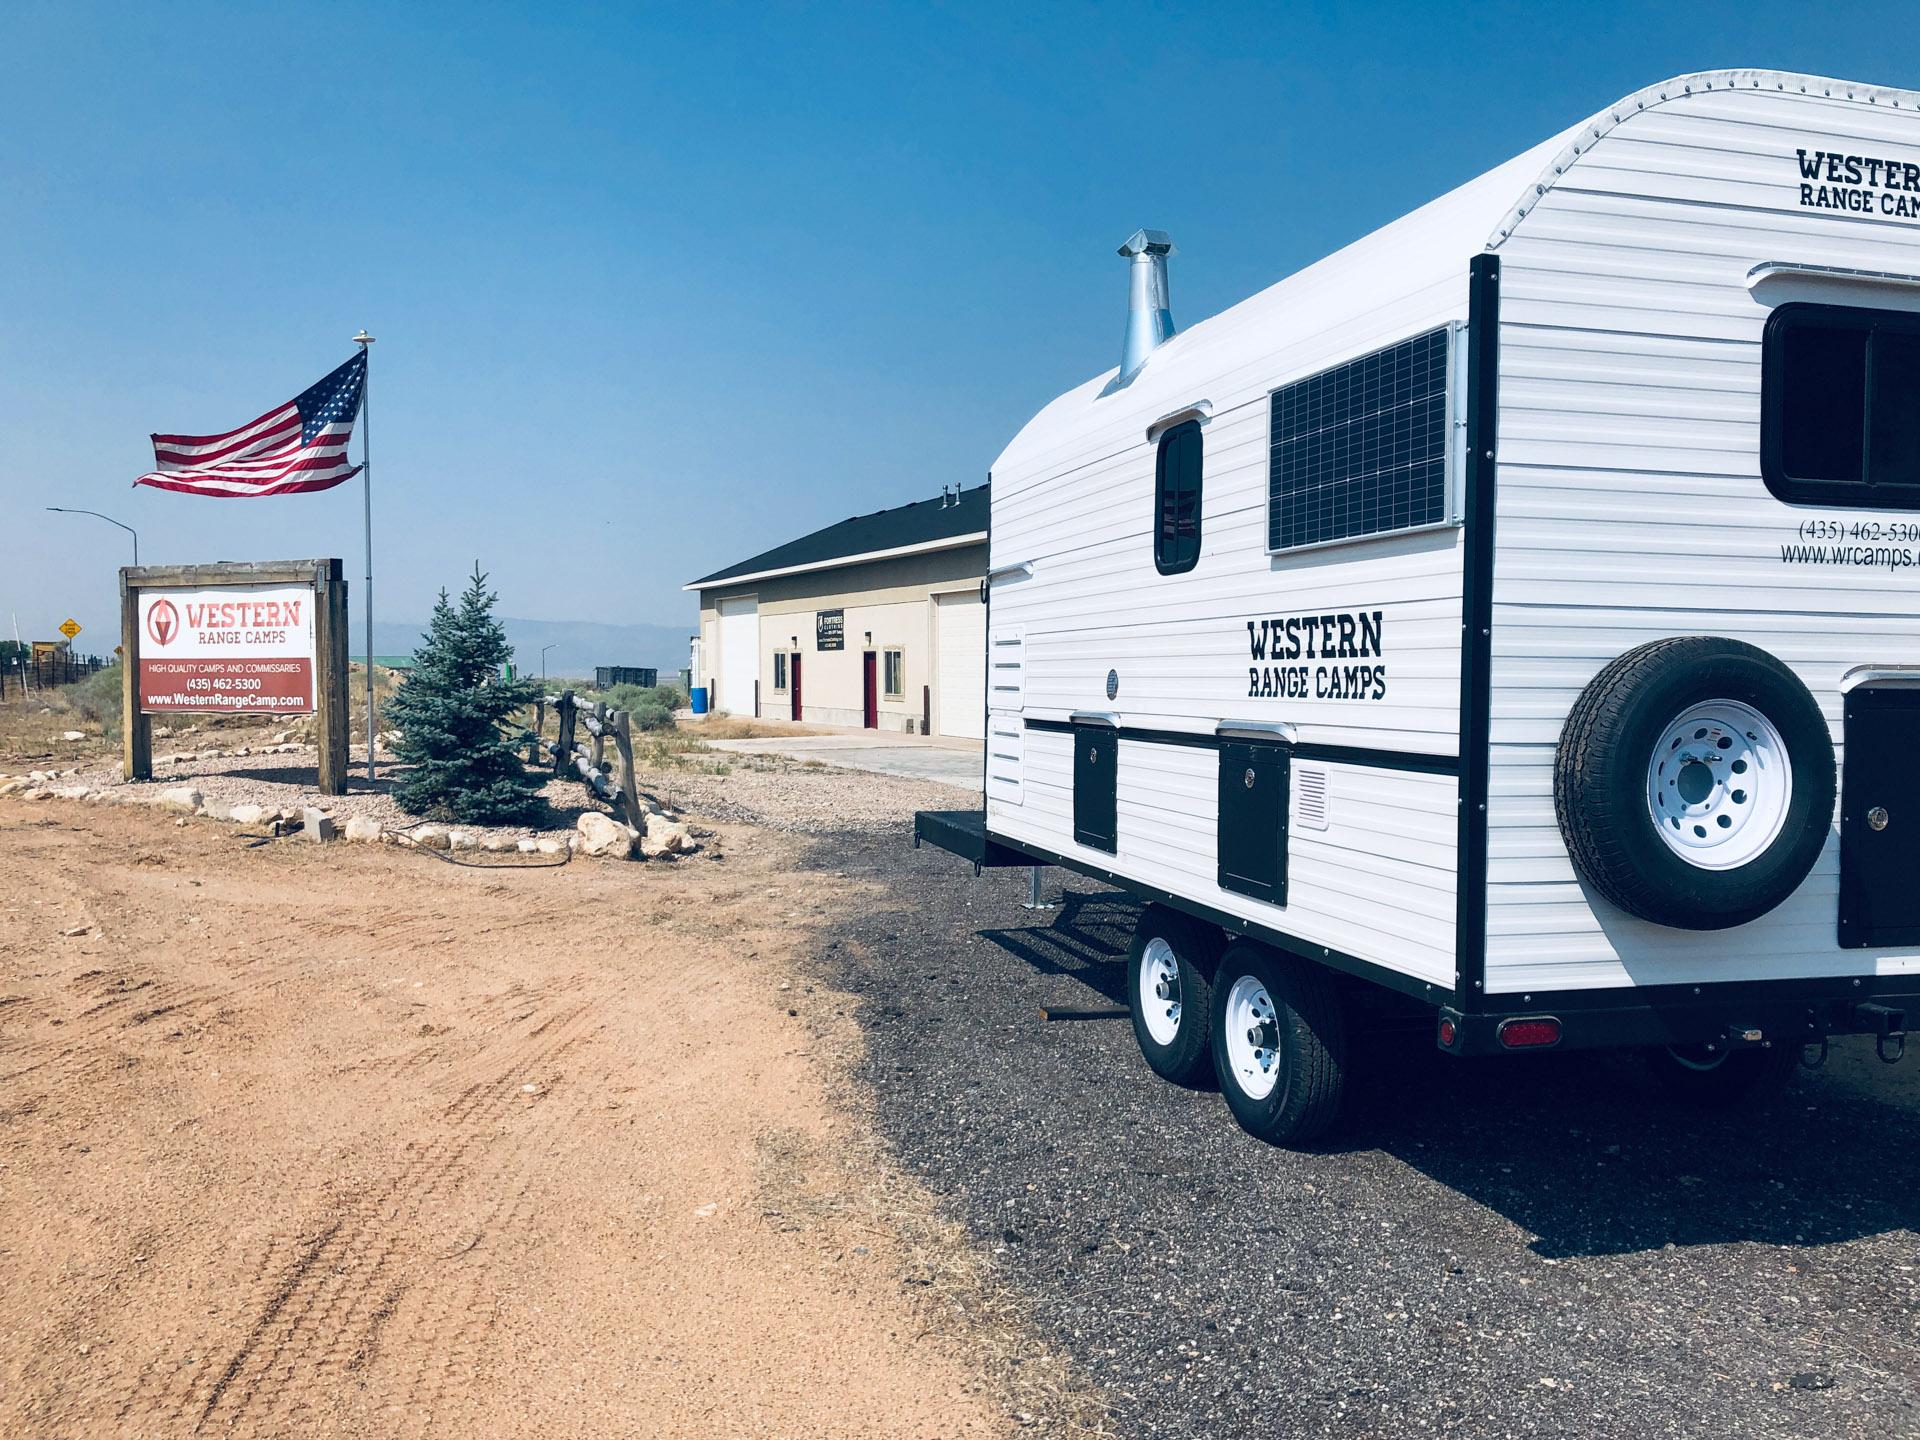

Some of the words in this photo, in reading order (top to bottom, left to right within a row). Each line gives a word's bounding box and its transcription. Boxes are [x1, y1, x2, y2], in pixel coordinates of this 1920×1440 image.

[1800, 183, 1874, 213] RANGE
[1799, 519, 1845, 544] (435)
[1850, 521, 1920, 542] 462-530
[1781, 544, 1920, 572] www.wrcamps.
[185, 601, 301, 628] WESTERN
[824, 616, 843, 624] FORTRESS
[198, 631, 241, 645] RANGE
[245, 630, 286, 644] CAMPS
[1247, 611, 1383, 660] WESTERN
[148, 664, 167, 673] HIGH
[167, 664, 197, 674] QUALITY
[198, 664, 225, 673] CAMPS
[226, 664, 244, 673] AND
[245, 663, 301, 673] COMMISSARIES
[186, 678, 211, 691] (435)
[213, 678, 261, 690] 462-5300
[1248, 666, 1309, 698] RANGE
[1316, 665, 1386, 700] CAMPS
[148, 693, 304, 708] www.WesternRangeCamp.com
